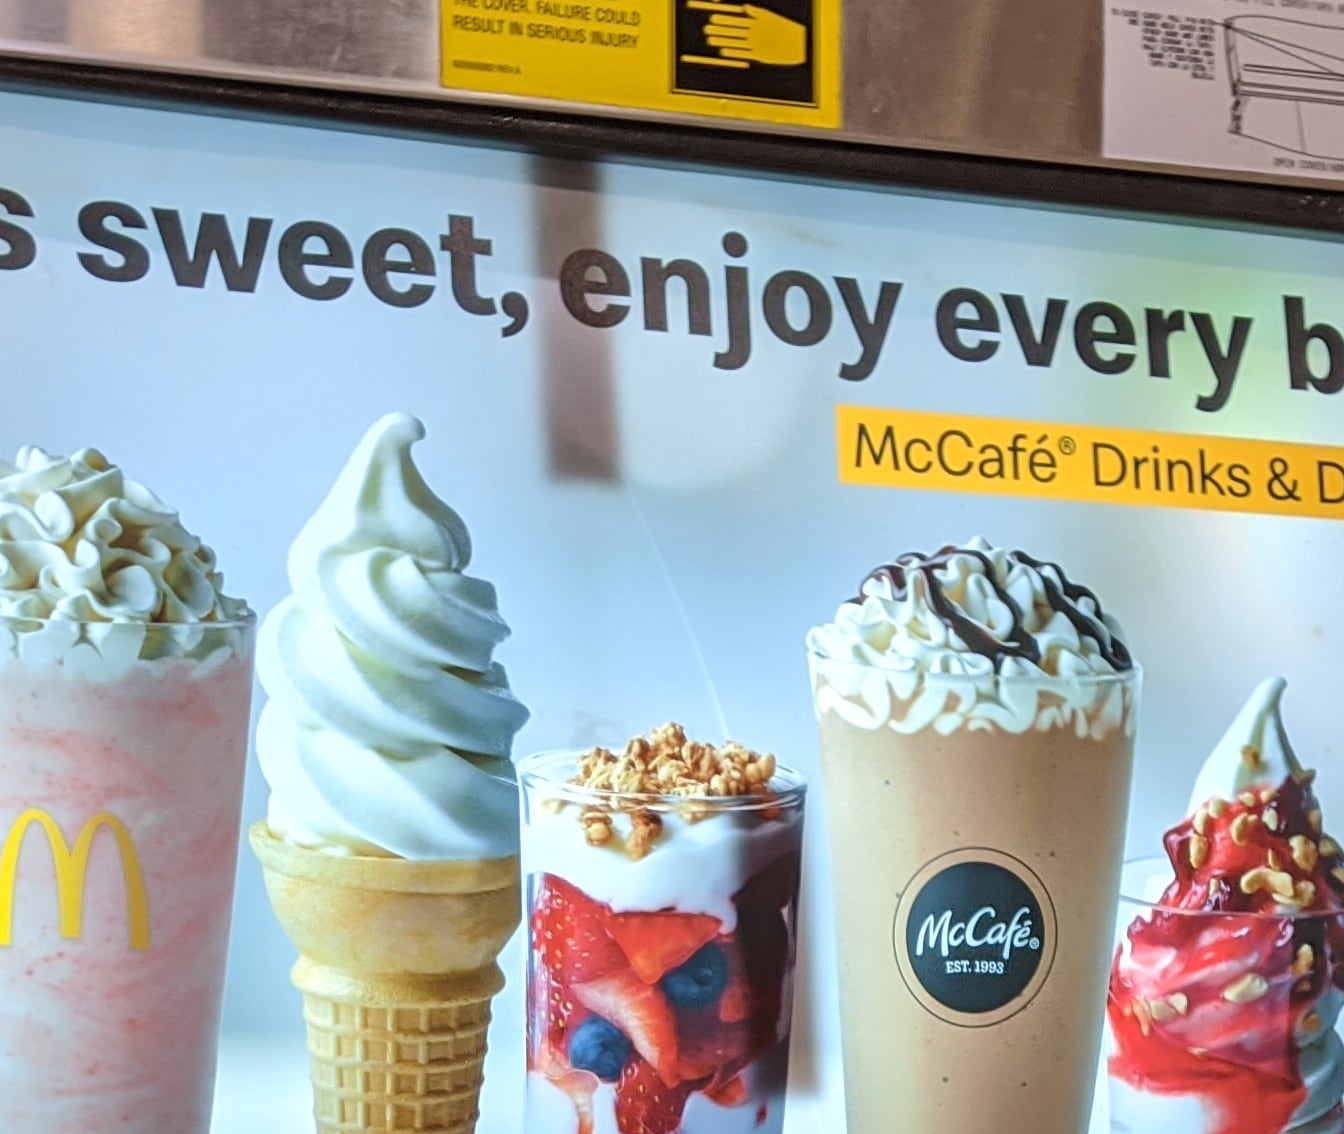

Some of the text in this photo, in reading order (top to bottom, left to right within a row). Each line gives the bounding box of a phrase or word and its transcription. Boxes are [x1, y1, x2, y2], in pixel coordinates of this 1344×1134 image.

[536, 0, 591, 20] FAILURE
[596, 7, 641, 26] COULD
[454, 14, 640, 48] RESULT IN SERIOUS INJURY
[76, 201, 530, 339] sweet,
[559, 231, 903, 380] enjoy
[936, 288, 1253, 412] every
[1091, 443, 1252, 500] Drinks
[1266, 457, 1301, 502] &
[946, 960, 1004, 974] EST. 1993
